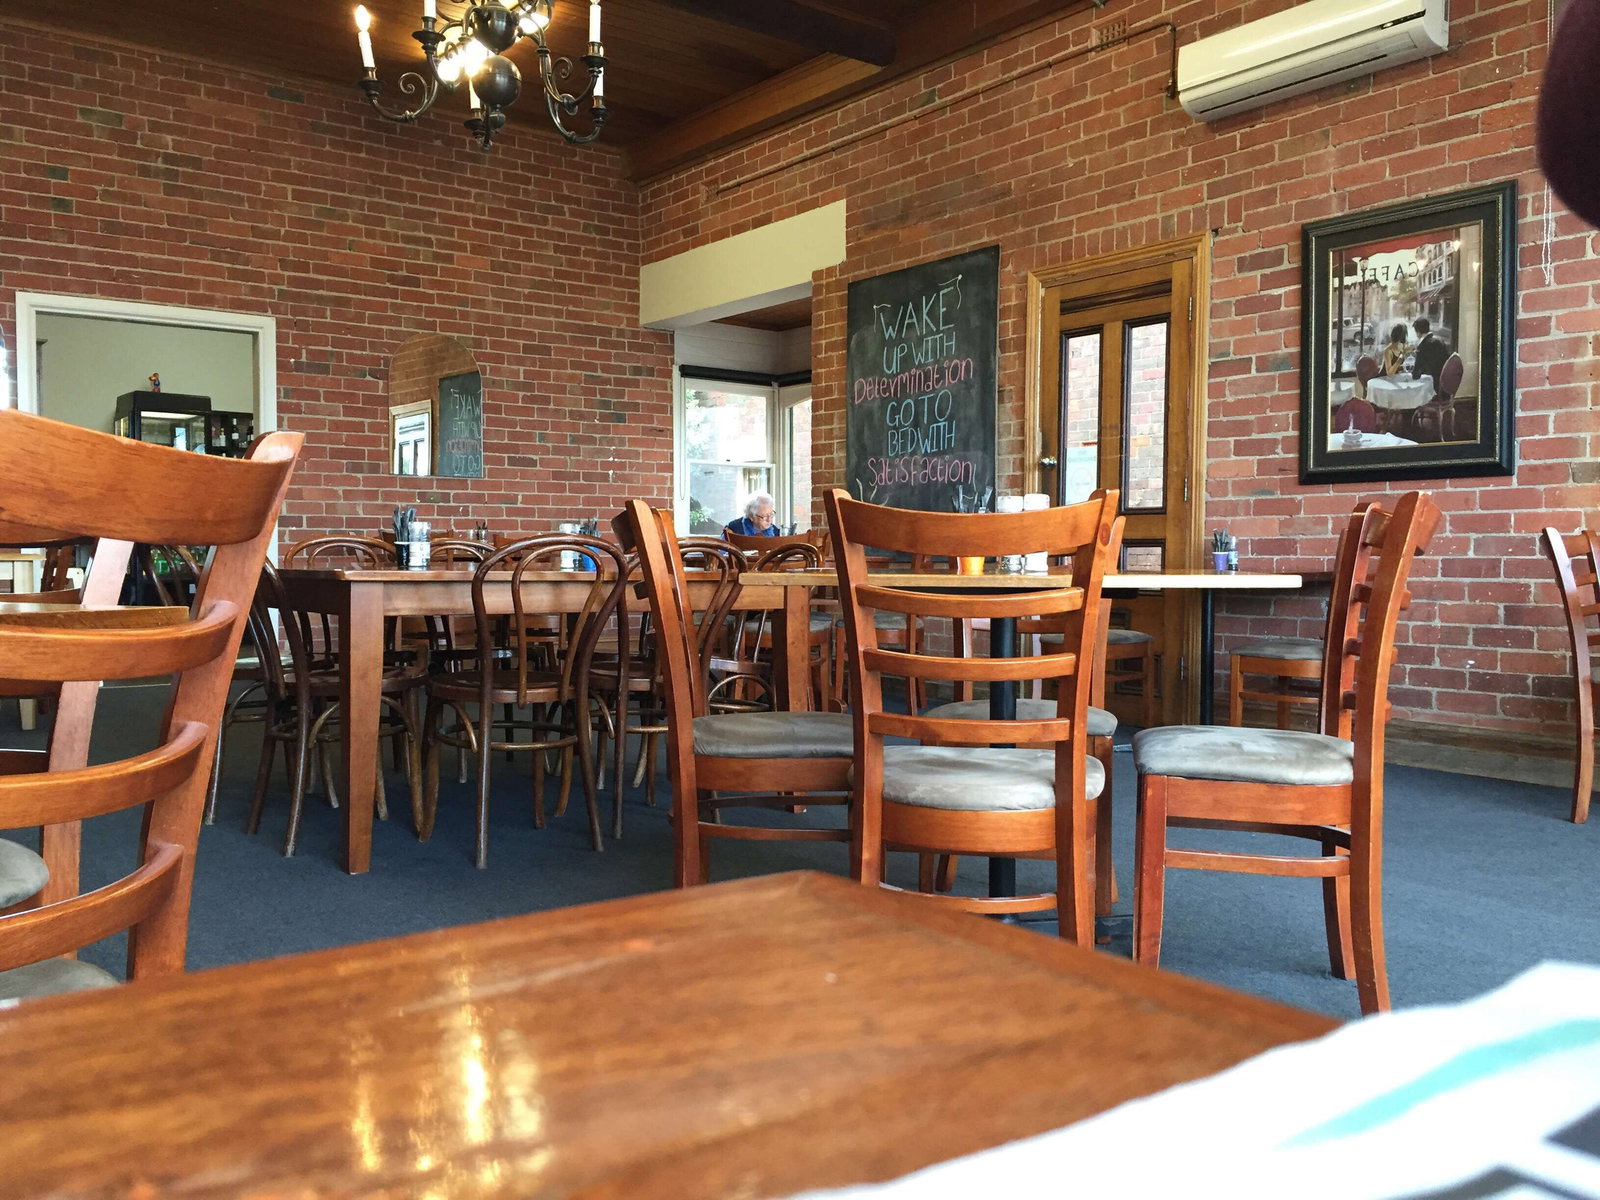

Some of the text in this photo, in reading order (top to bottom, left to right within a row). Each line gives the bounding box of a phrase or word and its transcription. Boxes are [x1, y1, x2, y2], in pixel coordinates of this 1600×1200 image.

[879, 286, 955, 341] WAKE
[883, 331, 956, 374] UP WITH
[854, 357, 974, 405] Determination
[886, 389, 952, 427] GO TO
[888, 420, 956, 457] BED WITH
[867, 455, 974, 487] Satisfaction
